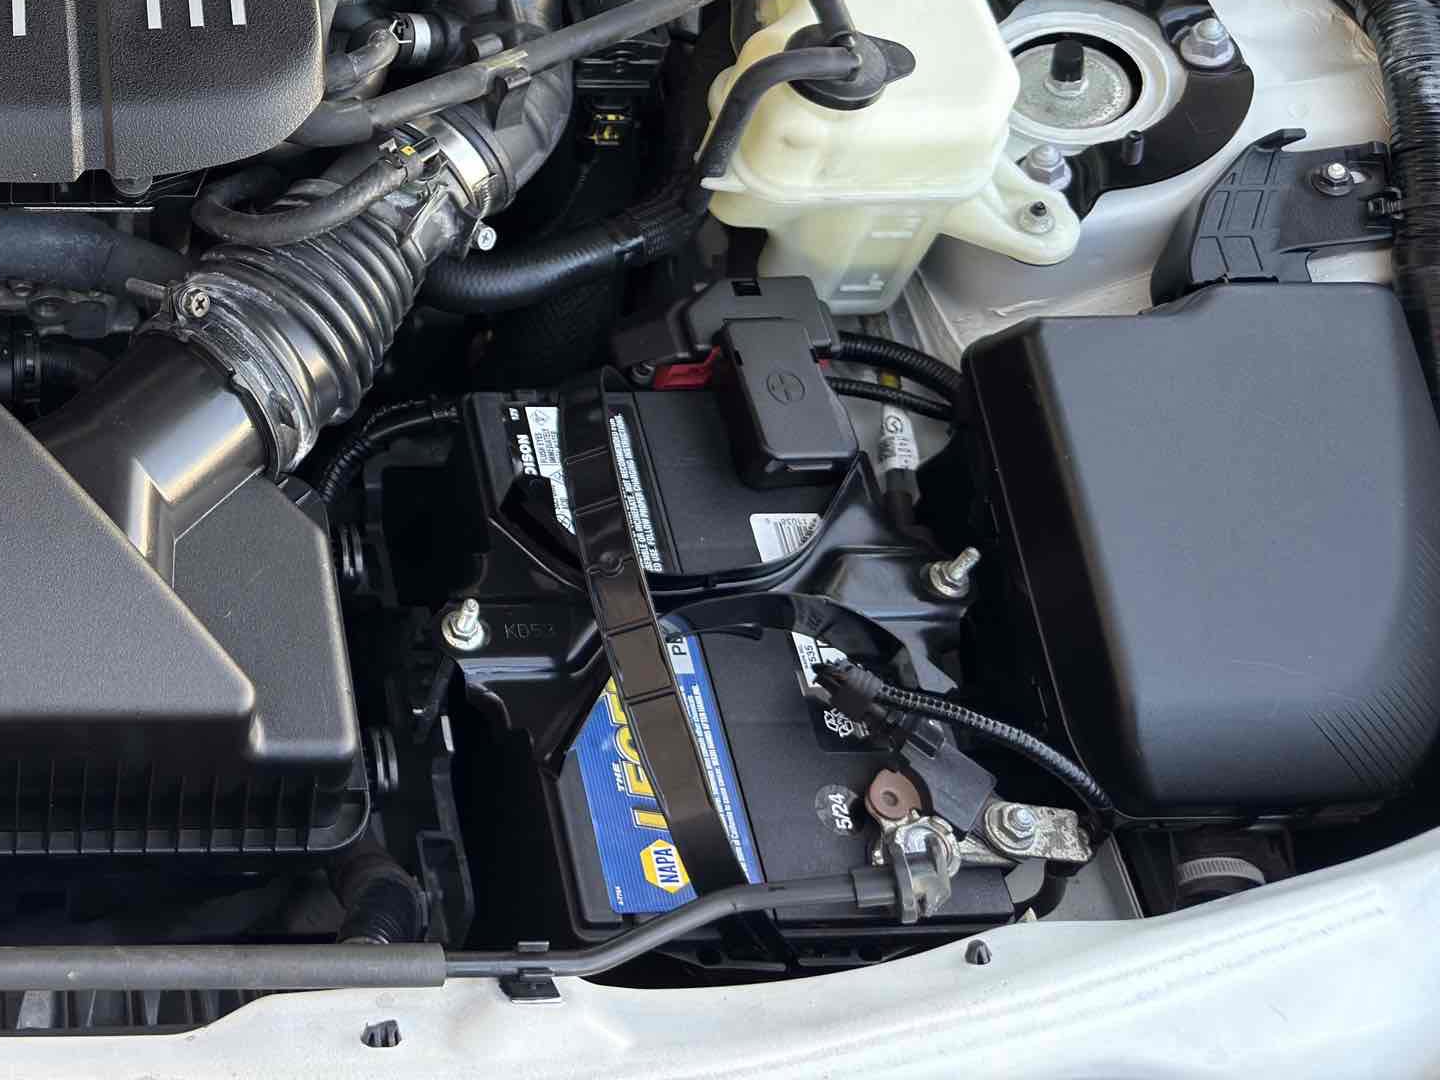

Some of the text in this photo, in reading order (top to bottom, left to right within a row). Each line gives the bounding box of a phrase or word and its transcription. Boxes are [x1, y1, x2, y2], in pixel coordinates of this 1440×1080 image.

[642, 518, 655, 545] FOLLOW
[612, 762, 626, 792] THE
[828, 793, 853, 830] 5/24
[660, 847, 679, 884] NAPA
